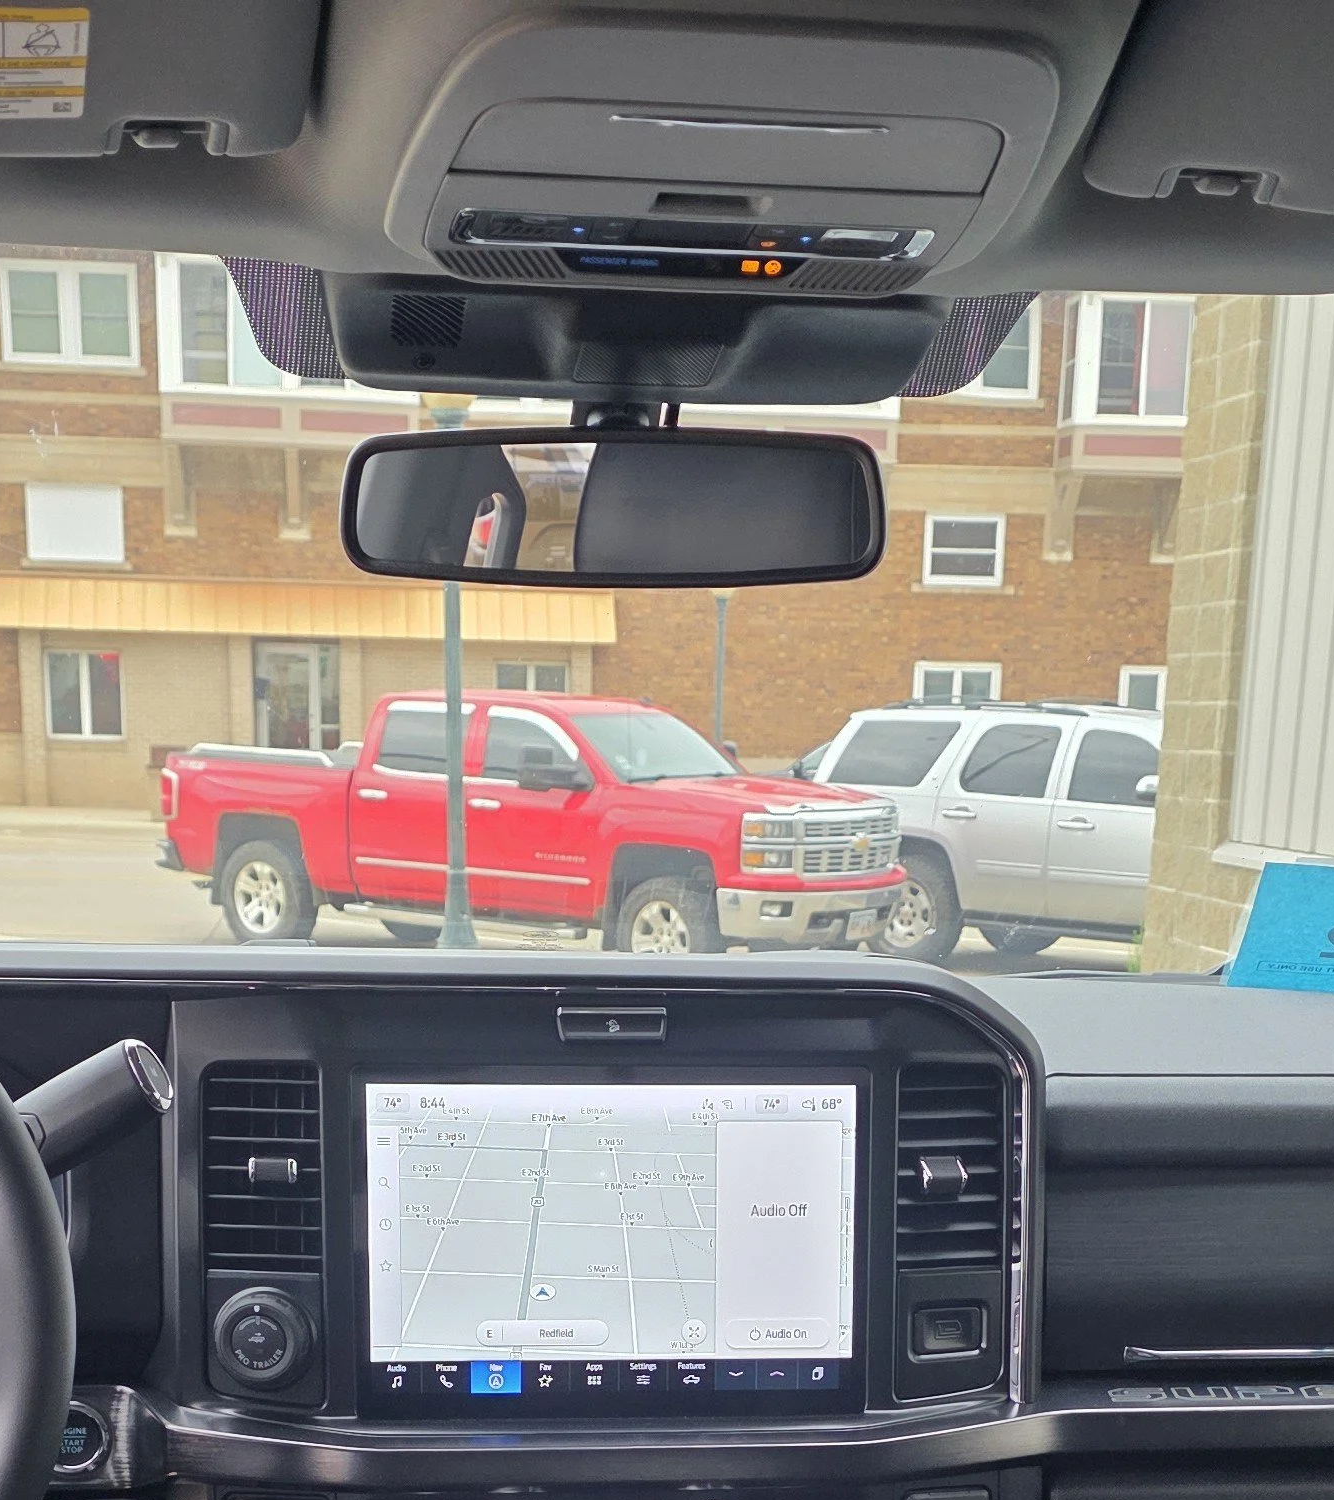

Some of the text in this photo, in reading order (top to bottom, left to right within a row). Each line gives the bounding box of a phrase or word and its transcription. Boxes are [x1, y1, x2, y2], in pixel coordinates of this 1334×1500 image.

[383, 1096, 842, 1110] 74° 8:44 74° 68°
[538, 1113, 550, 1122] 7th
[551, 1113, 567, 1123] Ave
[400, 1126, 427, 1135] 5th Ave
[444, 1132, 455, 1141] 3rd
[456, 1132, 466, 1141] St
[418, 1164, 430, 1172] 2nd
[431, 1164, 441, 1172] St
[527, 1168, 539, 1177] 2nd
[540, 1168, 550, 1177] St
[638, 1172, 650, 1180] 2nd
[651, 1172, 661, 1180] St
[750, 1204, 808, 1217] Audio Off
[432, 1217, 444, 1226] 6th
[444, 1217, 460, 1226] Ave
[592, 1265, 610, 1273] Main
[611, 1265, 620, 1273] St
[486, 1328, 574, 1339] E Redfield
[765, 1329, 807, 1339] Audio On
[235, 1349, 284, 1368] PRO TRAILER
[386, 1361, 706, 1373] Audio Phone Nav Fav Apps Settings Features
[61, 1446, 84, 1454] STOP
